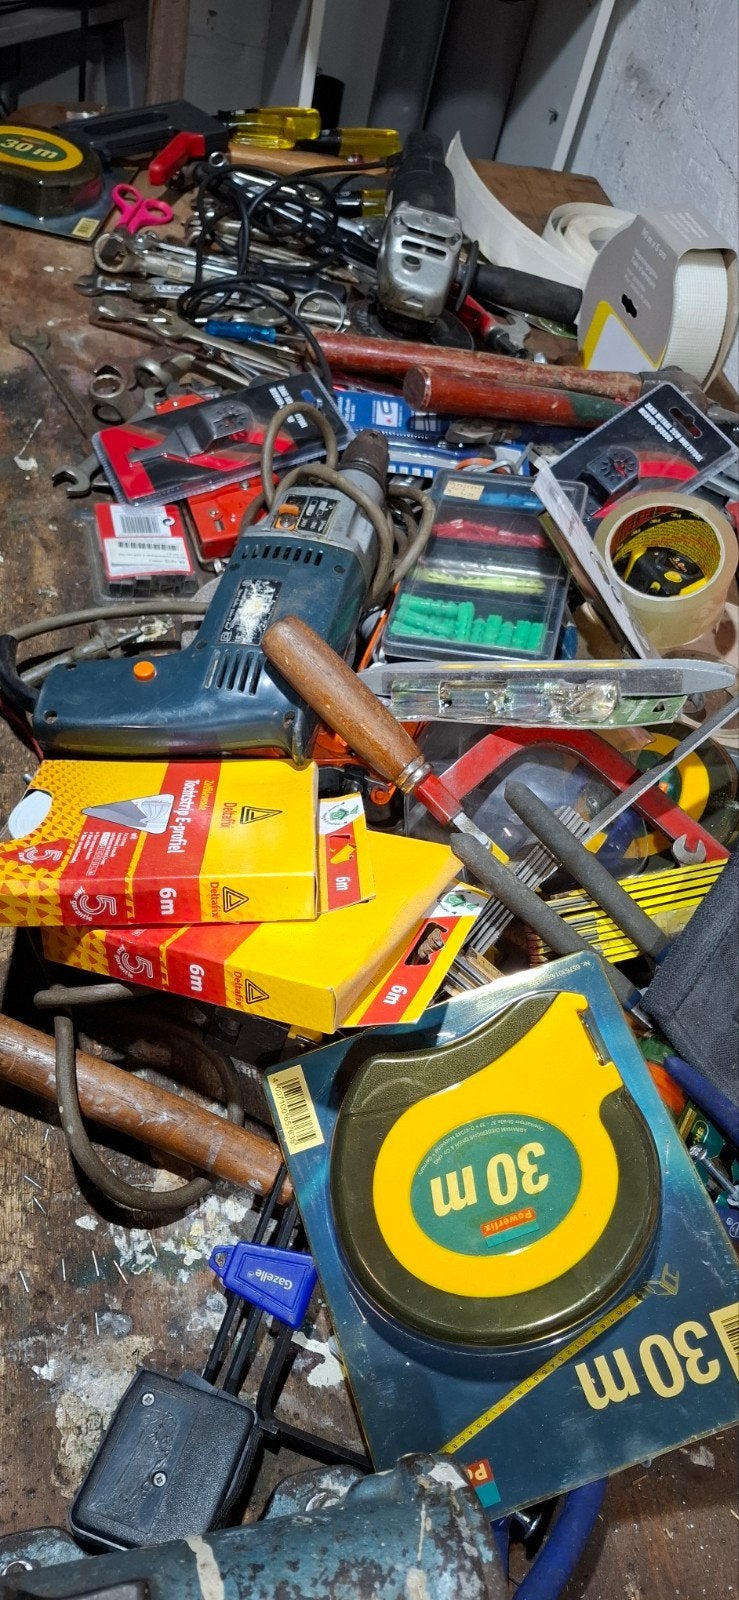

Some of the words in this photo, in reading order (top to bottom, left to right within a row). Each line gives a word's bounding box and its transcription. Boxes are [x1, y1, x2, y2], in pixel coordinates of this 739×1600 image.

[0, 138, 34, 152] 30
[32, 148, 59, 159] m
[678, 436, 704, 462] MULTITOOL
[174, 780, 200, 816] Tochtstrip
[220, 803, 237, 829] Deltafix
[167, 817, 192, 853] E-profiel
[335, 876, 350, 891] 6m
[70, 900, 92, 921] garantie
[80, 895, 117, 916] 5
[160, 887, 177, 916] 6m
[210, 882, 220, 918] Deltafix
[121, 953, 154, 978] 5
[190, 964, 205, 992] 6m
[233, 971, 244, 1006] Deltafix
[383, 984, 408, 1005] 6m
[417, 1156, 433, 1176] Germany
[486, 1142, 549, 1206] 30
[430, 1165, 477, 1217] m
[484, 1207, 534, 1232] Powerfix
[638, 1320, 721, 1398] 30
[574, 1347, 641, 1411] m
